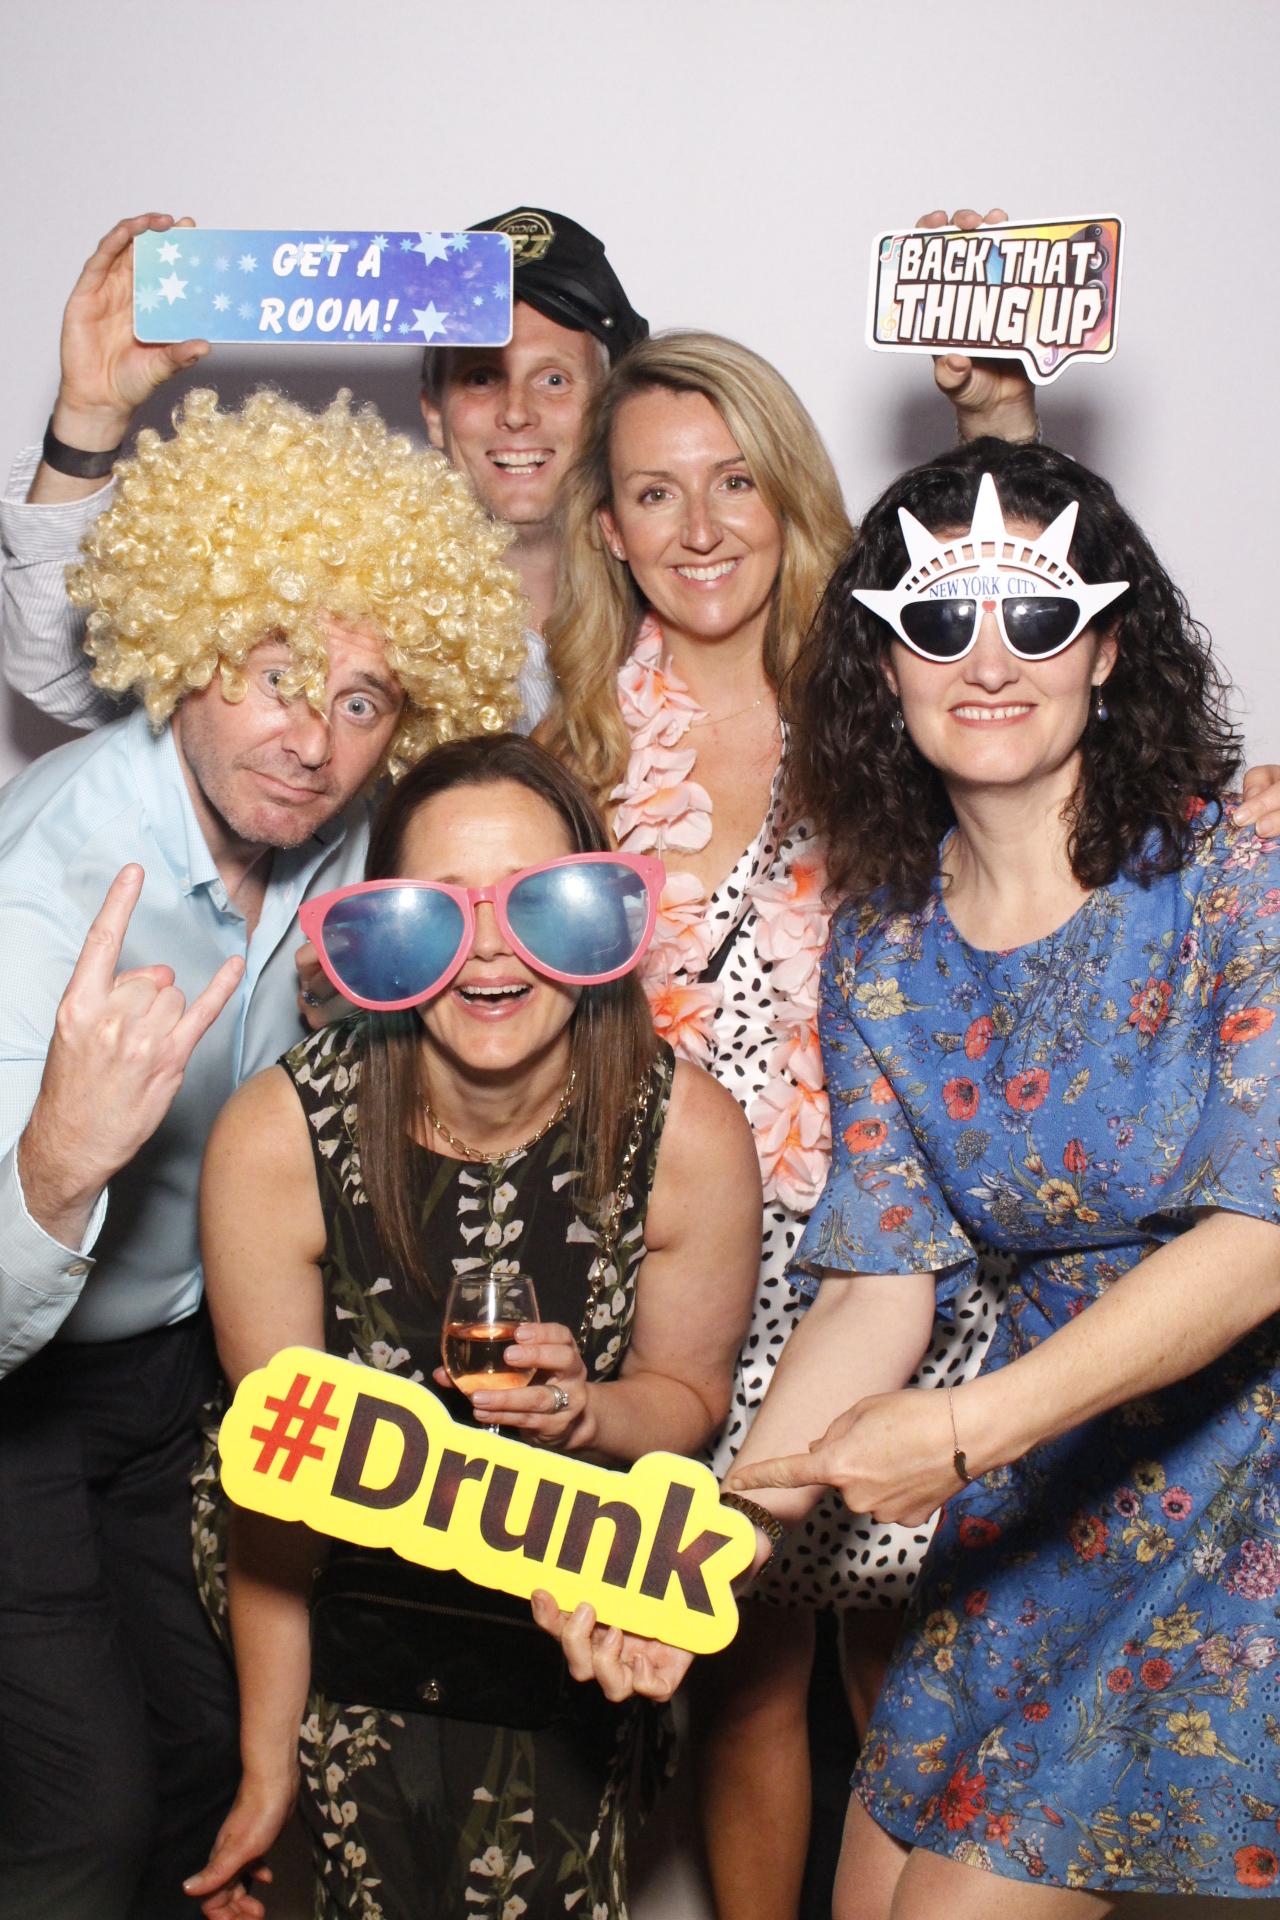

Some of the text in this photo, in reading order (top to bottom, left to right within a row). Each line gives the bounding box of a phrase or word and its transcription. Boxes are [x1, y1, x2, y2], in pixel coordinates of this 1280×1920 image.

[272, 242, 381, 278] GET A
[900, 238, 1096, 285] BACK THAT
[259, 298, 399, 333] ROOM!
[896, 284, 1102, 346] THING UP
[929, 576, 1038, 598] NEW YORK CITY
[250, 1373, 733, 1617] #Drunk
